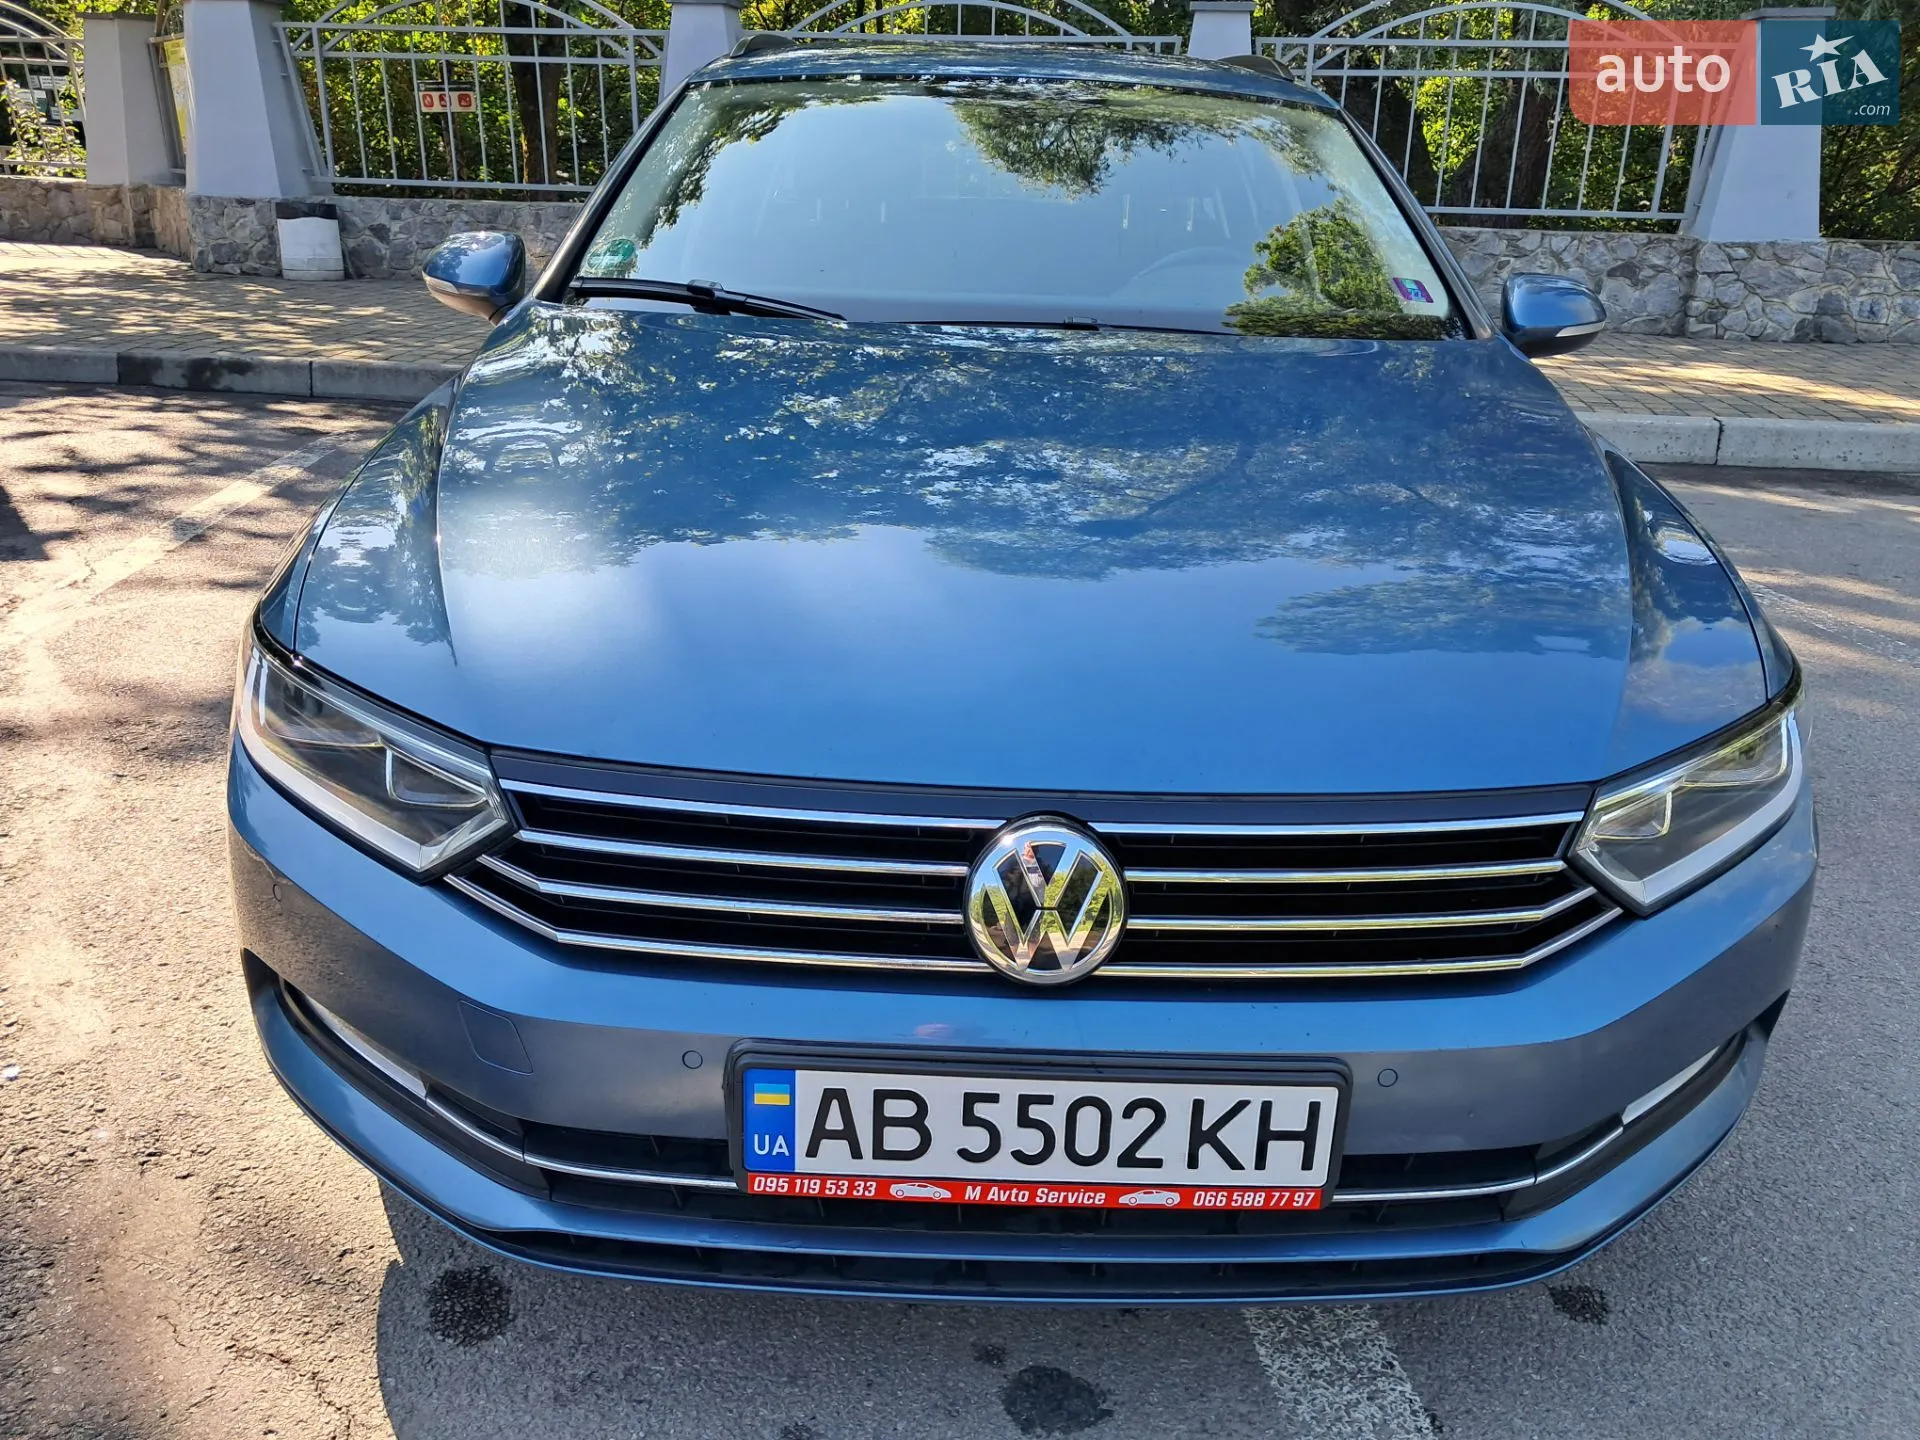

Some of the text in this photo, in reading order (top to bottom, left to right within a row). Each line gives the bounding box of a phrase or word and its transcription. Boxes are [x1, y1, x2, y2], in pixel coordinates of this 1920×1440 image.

[804, 1087, 1322, 1171] AB 5502 KH
[753, 1133, 790, 1157] UA
[753, 1177, 1316, 1207] 095 119 53 33 M Avto Service 066 588 77 97
